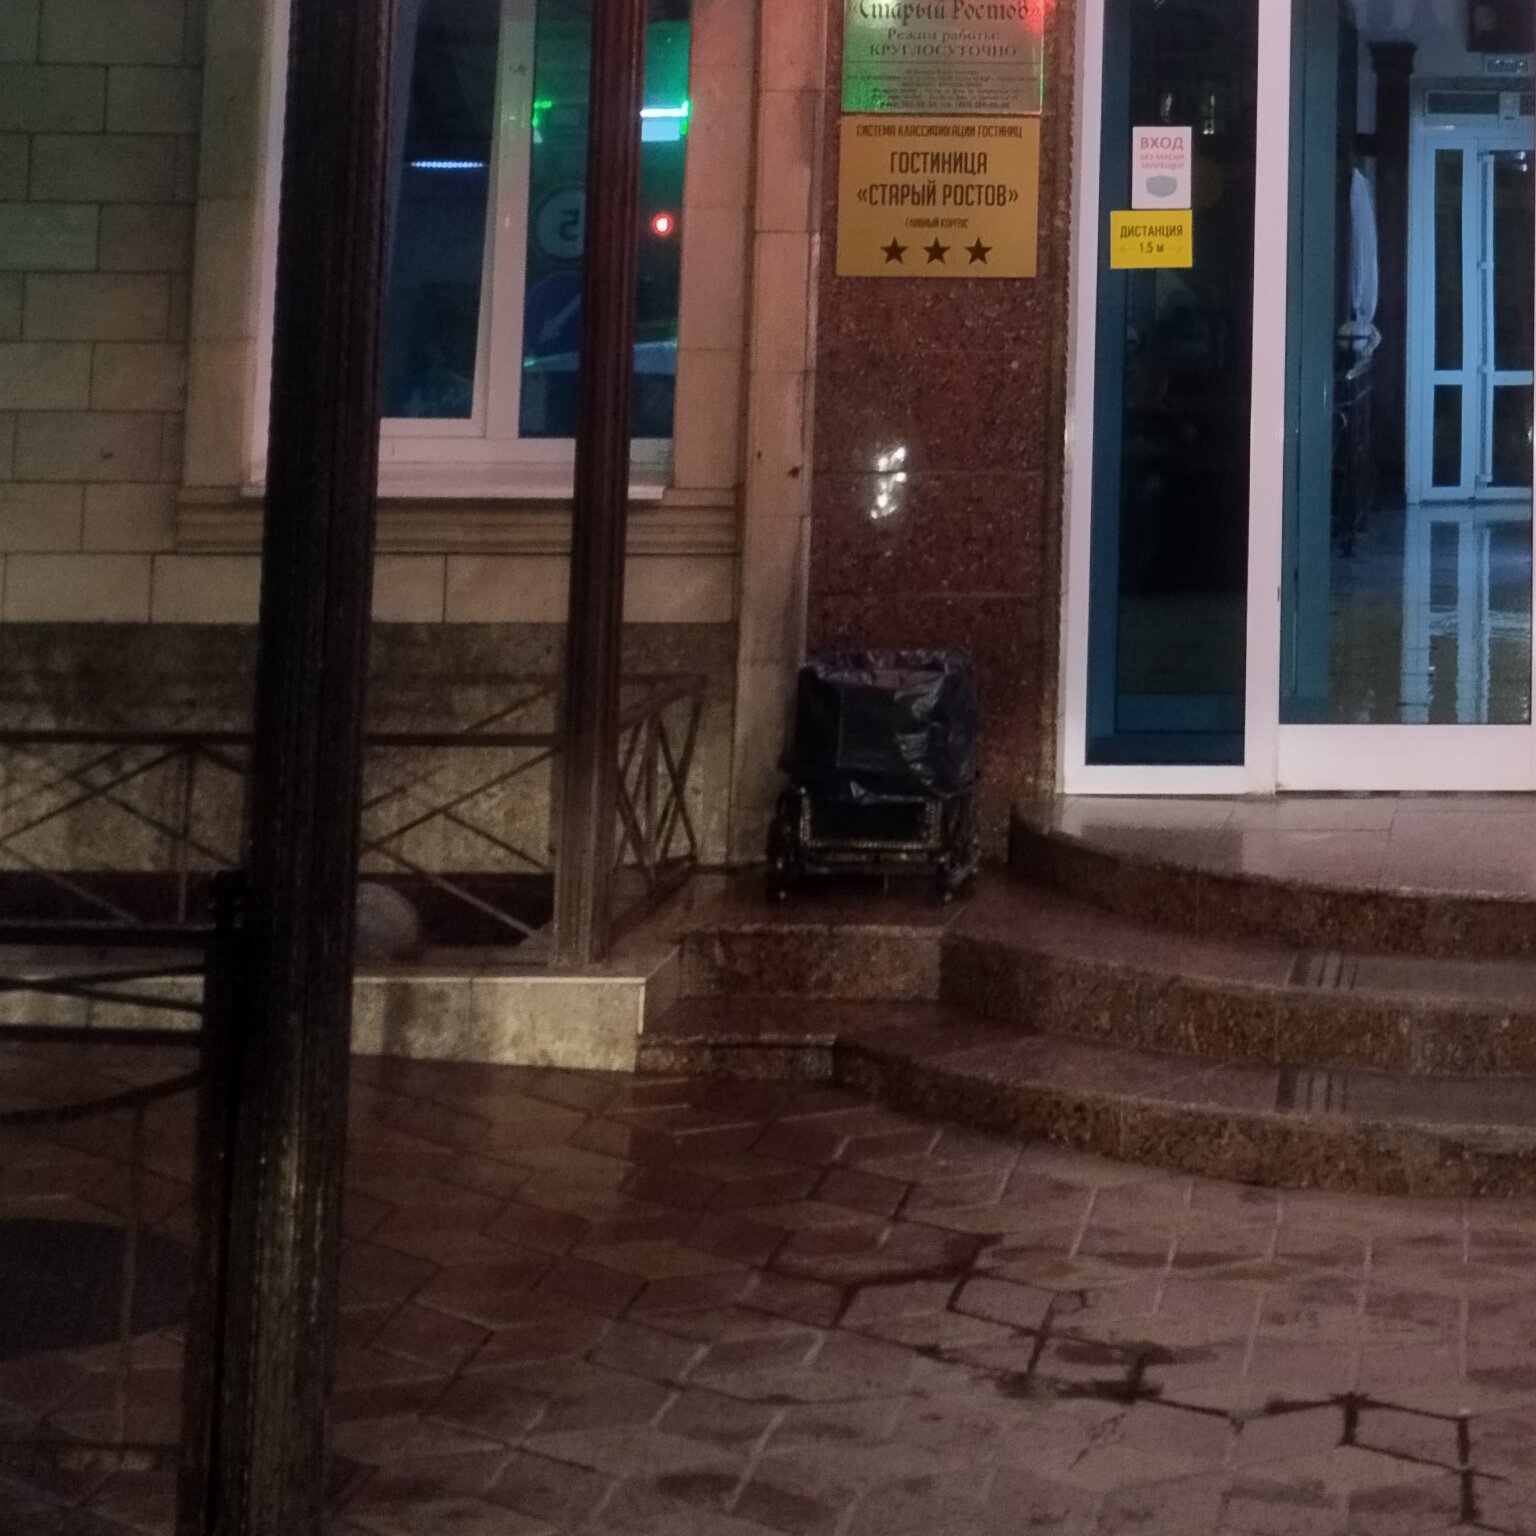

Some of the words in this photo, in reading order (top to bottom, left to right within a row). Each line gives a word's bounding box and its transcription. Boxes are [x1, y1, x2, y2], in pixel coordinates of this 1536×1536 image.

[869, 43, 1017, 58] КРУГЛОСУТОЧНО
[856, 124, 896, 137] СИСТЕМА
[1140, 136, 1184, 152] ВХОД
[890, 151, 988, 176] ГОСТИНИЦА
[857, 179, 936, 207] «СТАРЫЙ
[942, 183, 1019, 207] РОСТОВ»
[1120, 224, 1183, 239] ДИСТАНЦИЯ
